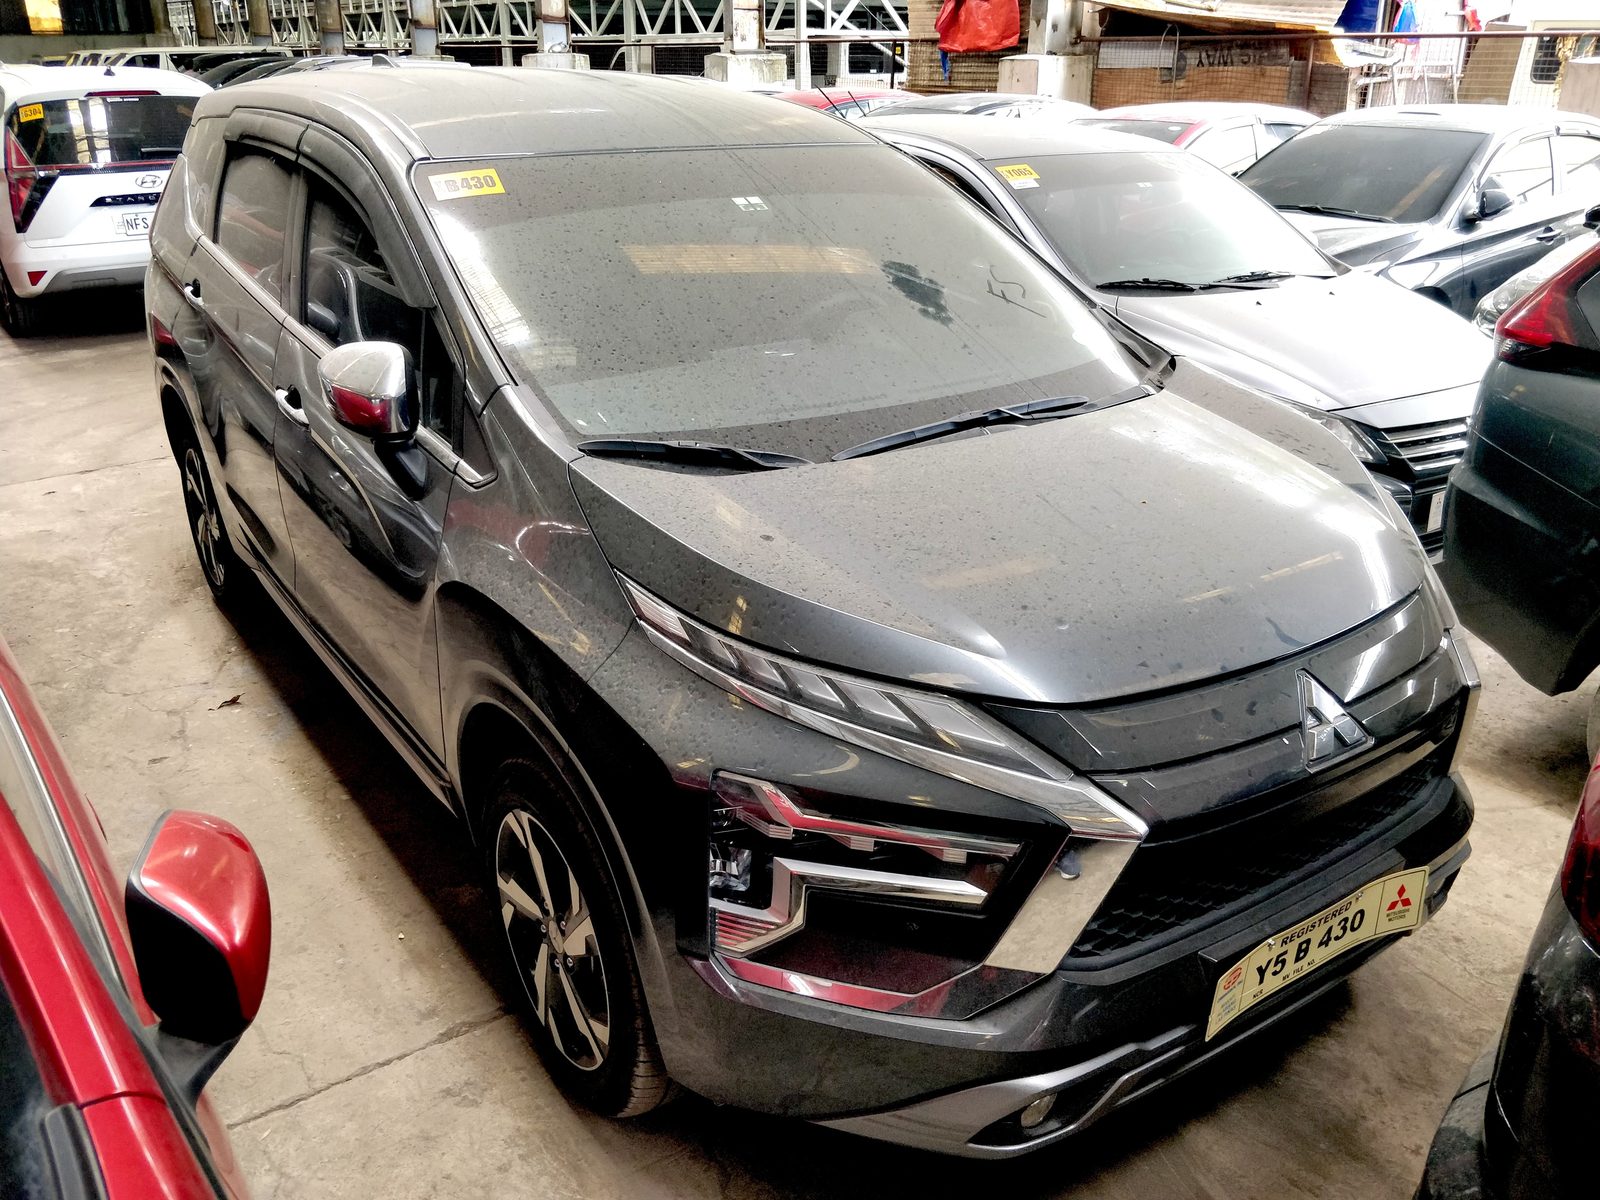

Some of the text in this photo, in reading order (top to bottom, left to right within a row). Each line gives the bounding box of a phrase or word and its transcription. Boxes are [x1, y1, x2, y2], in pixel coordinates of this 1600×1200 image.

[444, 175, 497, 192] B430
[126, 217, 149, 231] NFS
[1280, 900, 1353, 947] REGISTERED
[1256, 909, 1366, 986] Y5 B 430
[1293, 965, 1304, 975] FILE
[1252, 989, 1264, 999] NCR
